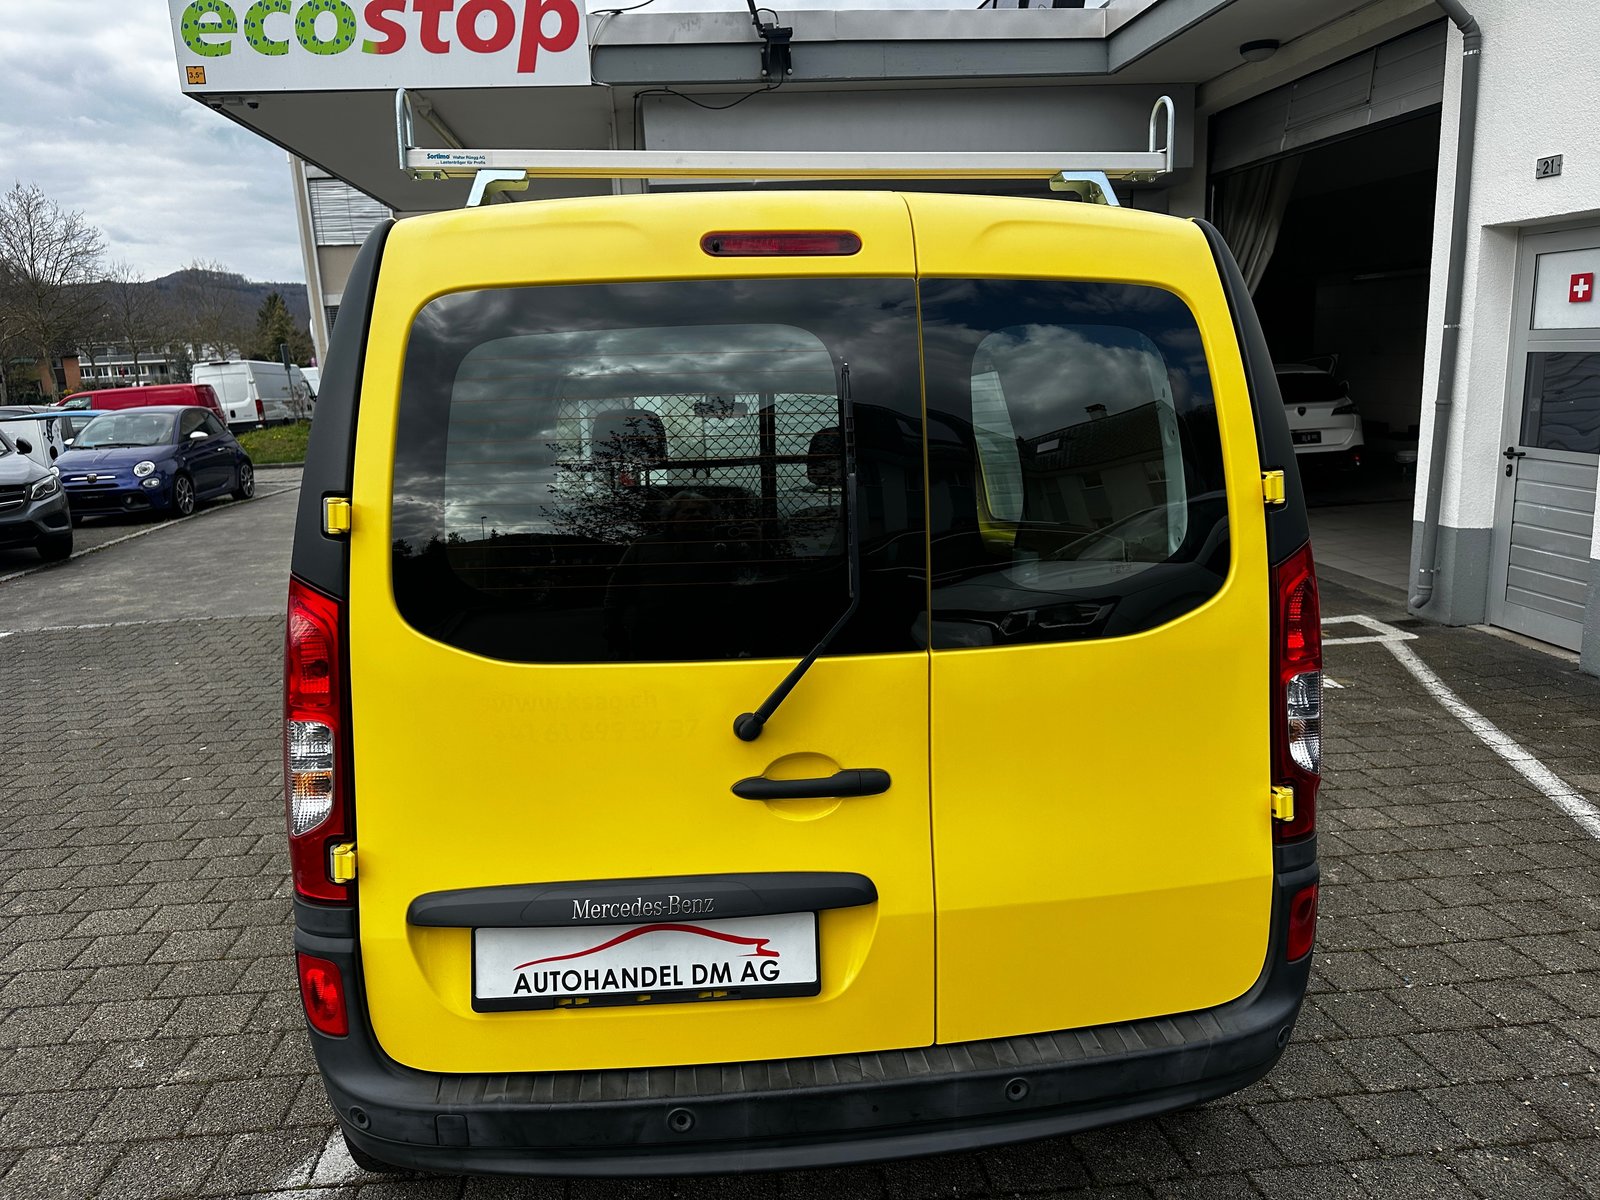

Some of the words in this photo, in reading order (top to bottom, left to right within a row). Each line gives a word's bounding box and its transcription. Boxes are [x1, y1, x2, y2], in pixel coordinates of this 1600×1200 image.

[180, 0, 581, 74] ecostop
[1542, 159, 1555, 175] 21
[571, 895, 715, 920] Mercedes-Benz
[513, 965, 684, 995] AUTOHANDEL
[691, 961, 733, 985] DM
[740, 959, 781, 983] AG
